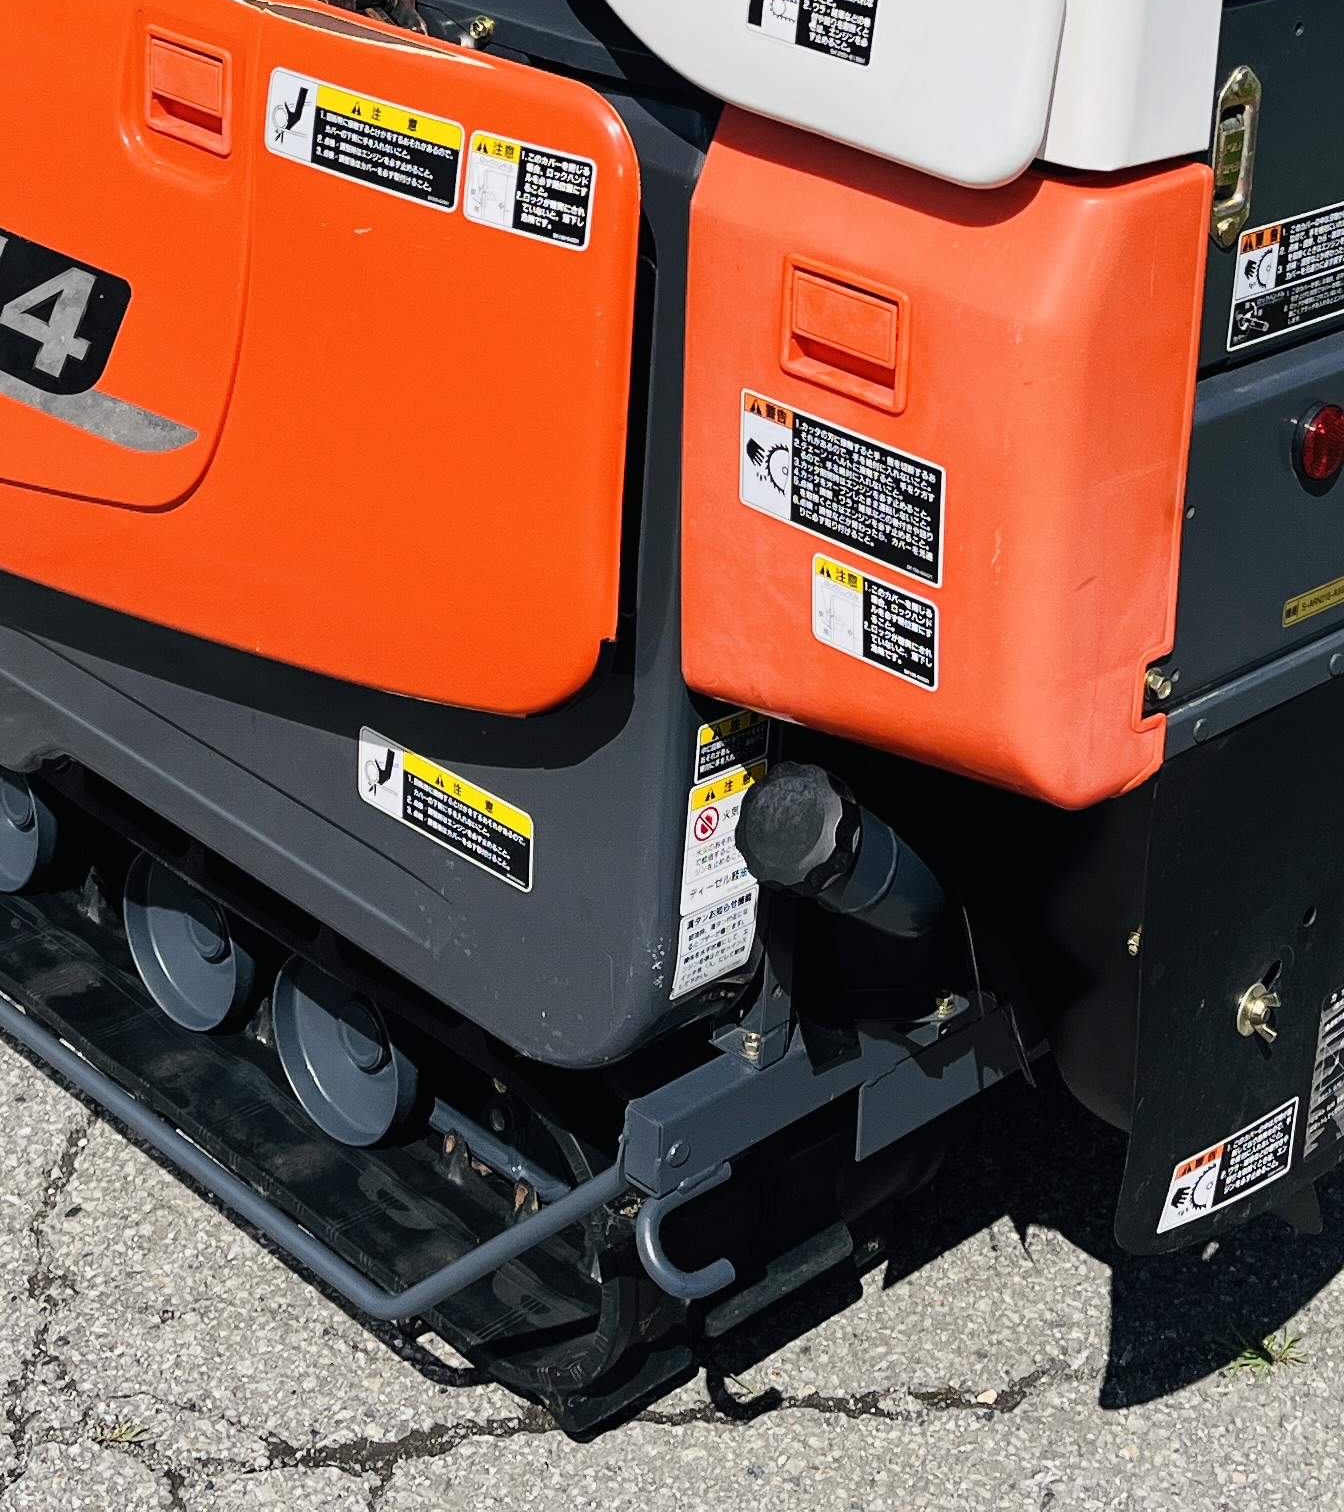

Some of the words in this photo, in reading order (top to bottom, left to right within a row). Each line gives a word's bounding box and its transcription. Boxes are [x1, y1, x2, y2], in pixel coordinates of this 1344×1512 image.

[372, 106, 418, 133] 注意
[492, 141, 515, 159] 注意
[836, 568, 857, 589] 注意
